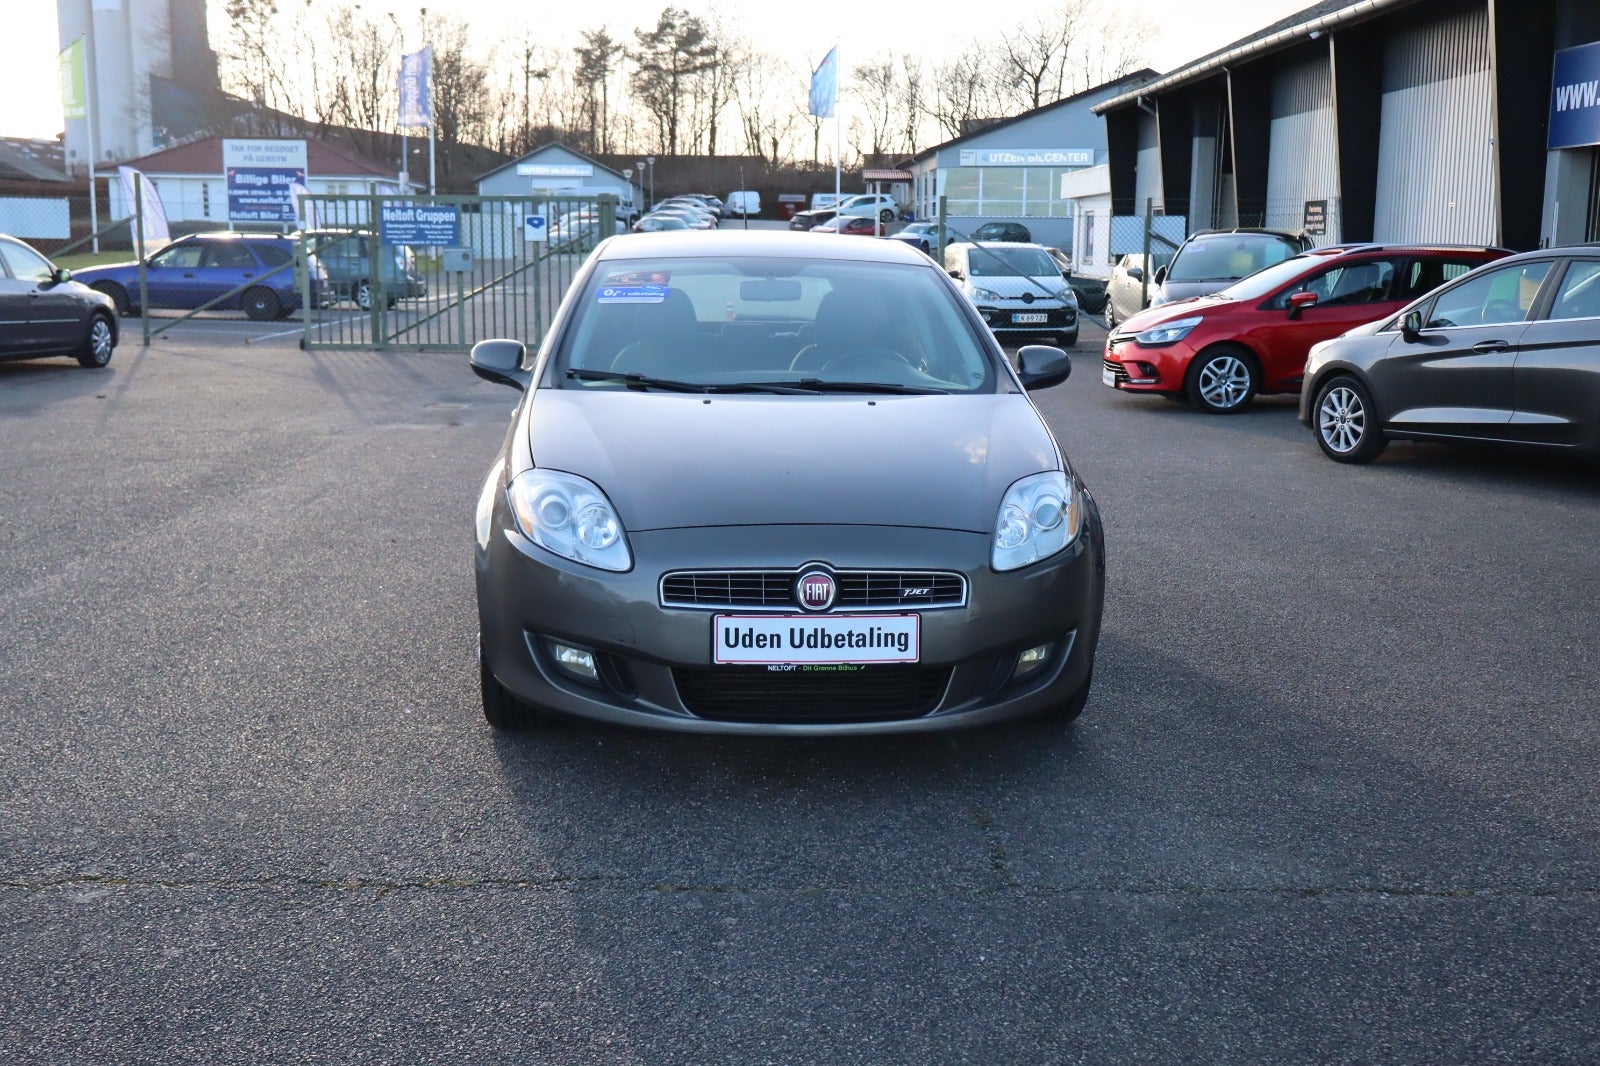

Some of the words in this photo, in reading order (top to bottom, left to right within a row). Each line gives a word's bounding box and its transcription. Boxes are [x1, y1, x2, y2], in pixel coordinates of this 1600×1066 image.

[235, 174, 269, 186] Billige
[271, 174, 297, 184] Biler
[383, 209, 415, 221] Neltoft
[416, 209, 456, 224] Gruppen
[806, 583, 829, 601] FIAT
[724, 627, 782, 649] Uden
[789, 627, 909, 652] Udbetaling
